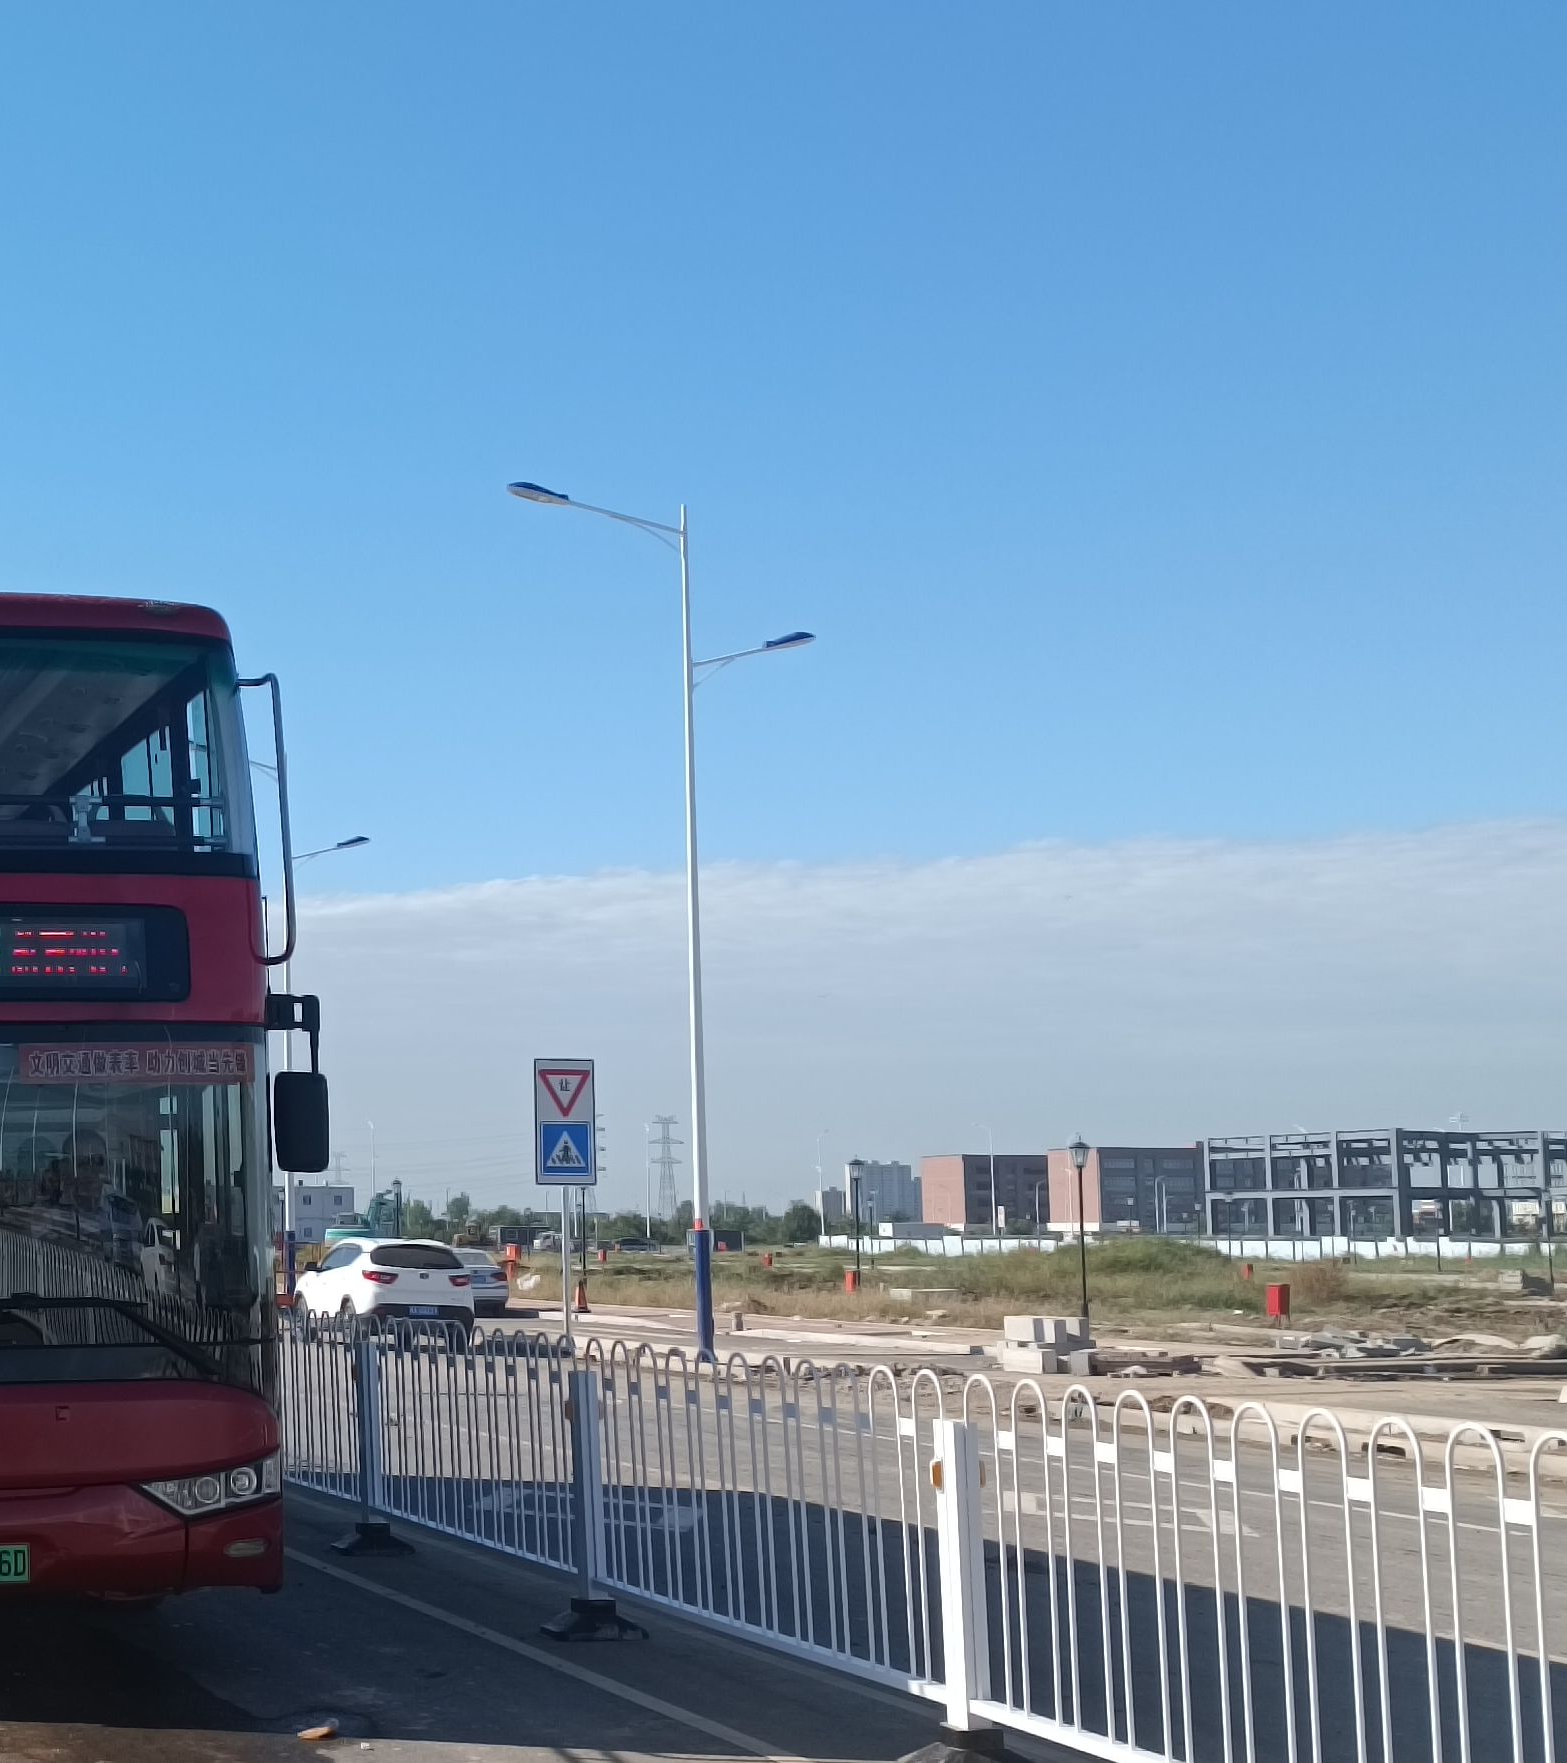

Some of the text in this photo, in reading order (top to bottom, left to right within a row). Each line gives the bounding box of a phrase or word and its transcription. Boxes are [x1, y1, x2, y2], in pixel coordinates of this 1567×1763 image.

[28, 1049, 139, 1077] 文明交通做表率
